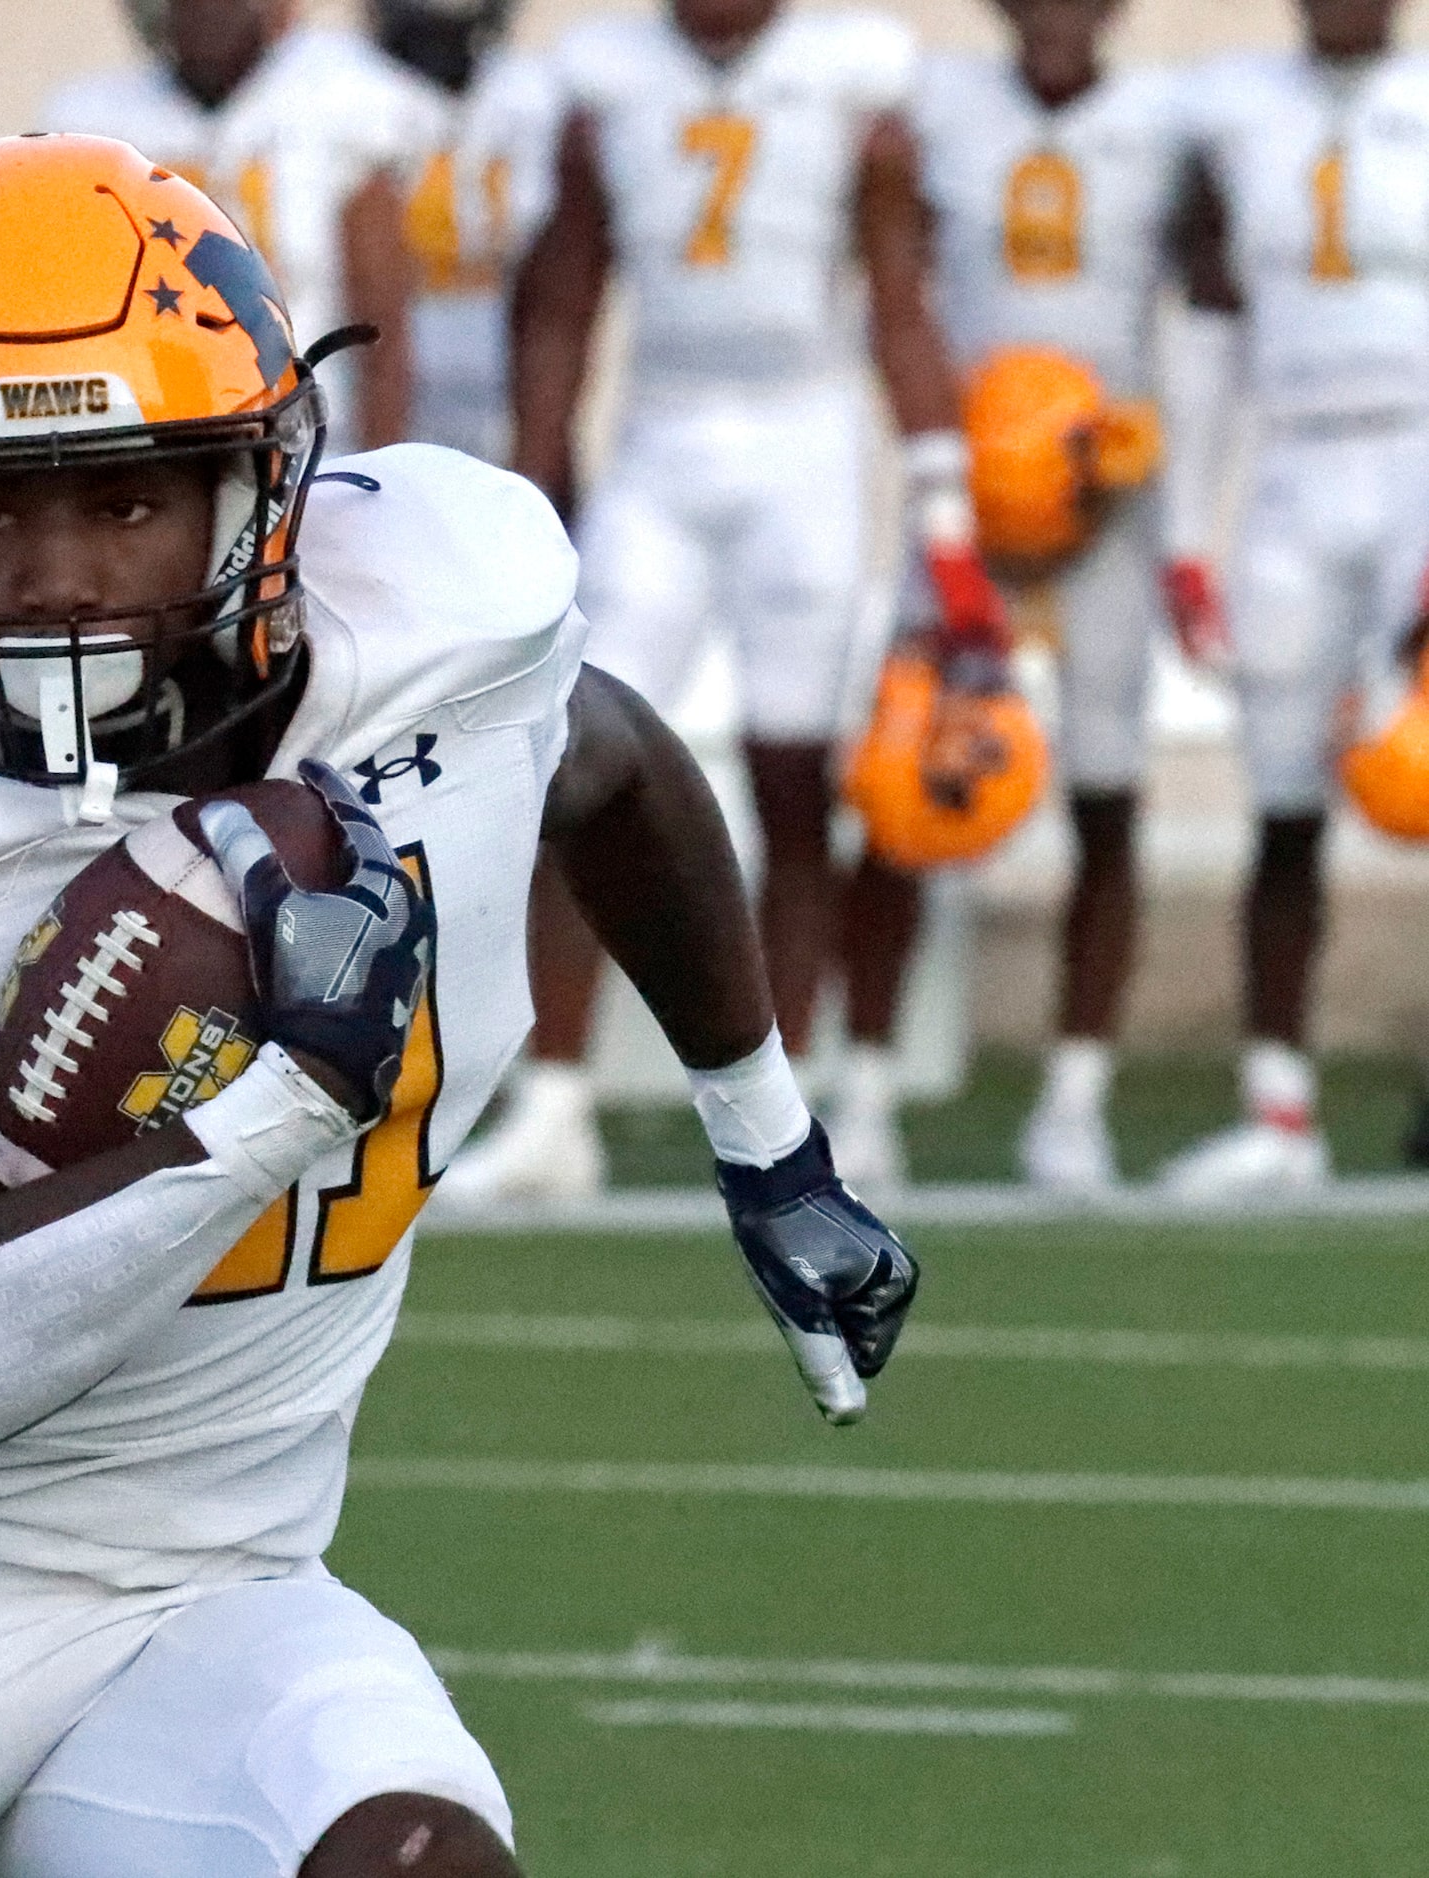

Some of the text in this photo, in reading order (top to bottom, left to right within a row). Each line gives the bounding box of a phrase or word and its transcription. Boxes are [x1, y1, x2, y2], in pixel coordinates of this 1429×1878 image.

[681, 115, 755, 266] 7
[1309, 156, 1356, 283] 1
[146, 1023, 226, 1131] LIONS
[179, 840, 448, 1308] 1
